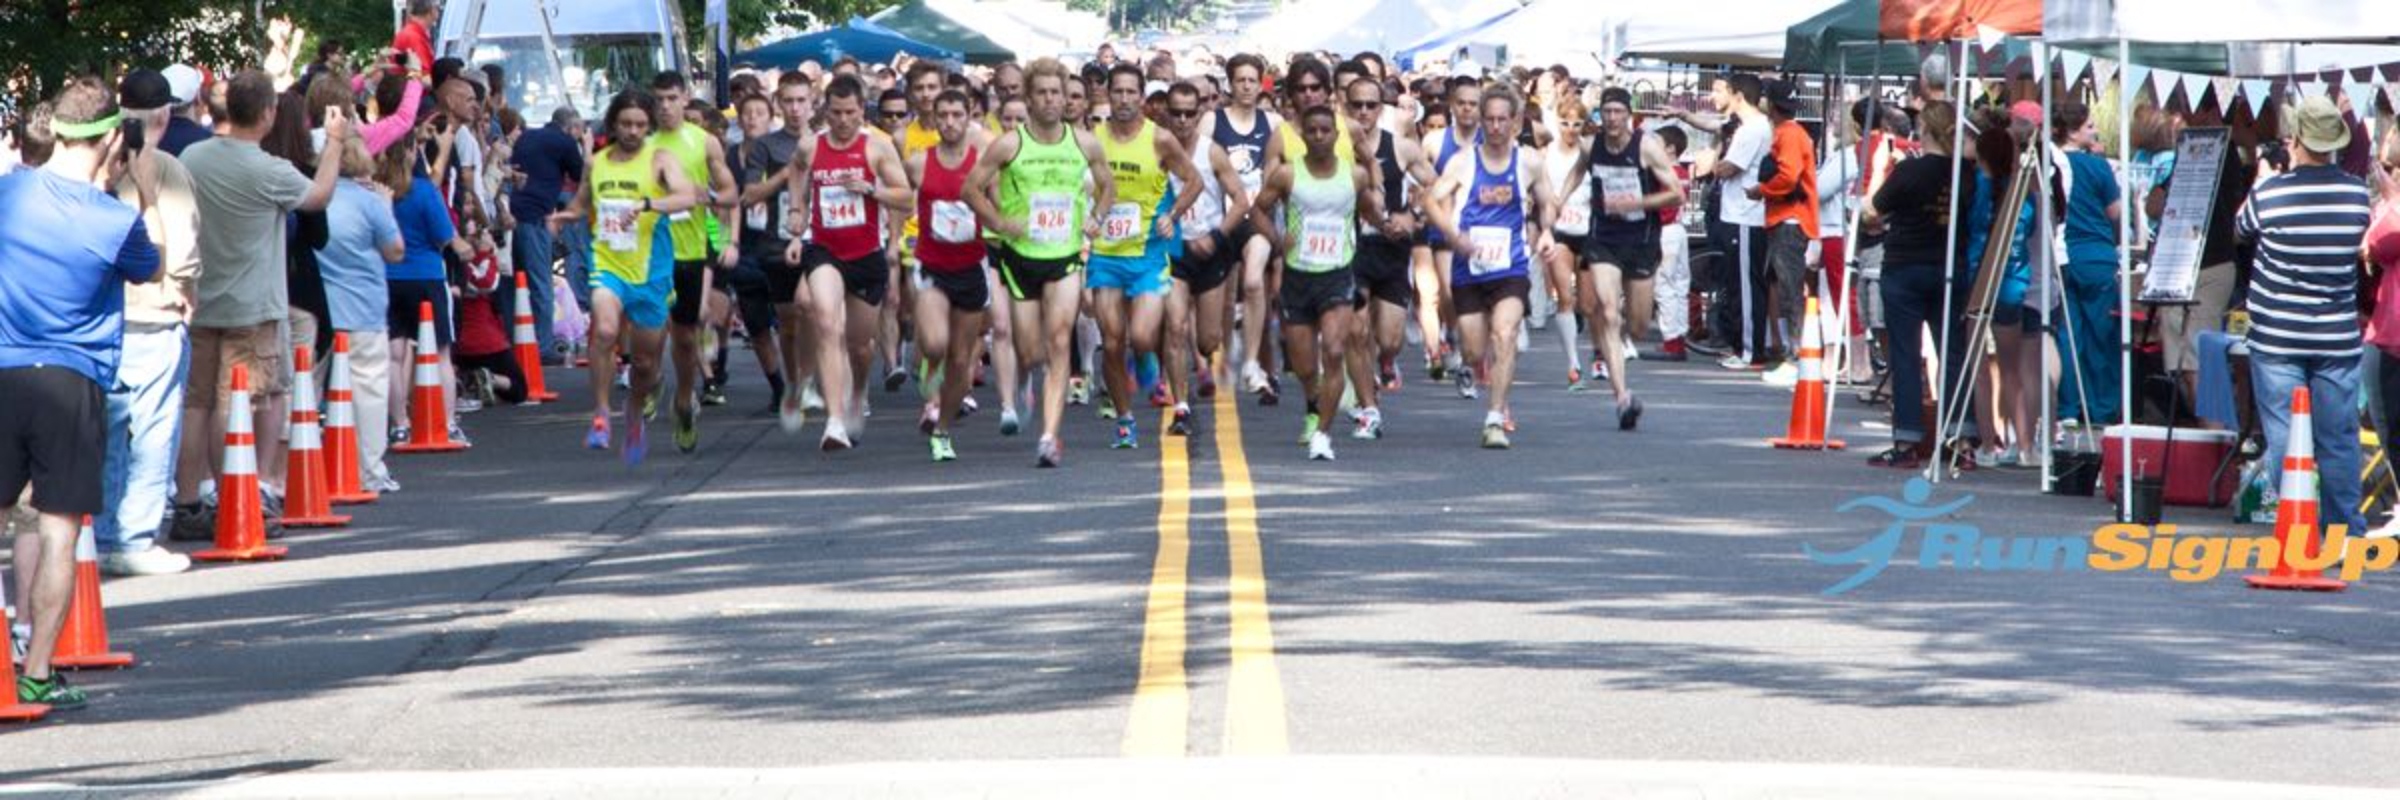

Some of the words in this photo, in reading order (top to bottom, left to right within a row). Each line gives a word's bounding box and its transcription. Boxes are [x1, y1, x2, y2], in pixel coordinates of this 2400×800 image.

[830, 201, 856, 219] 944
[1107, 219, 1132, 237] 697
[1308, 234, 1337, 254] 912
